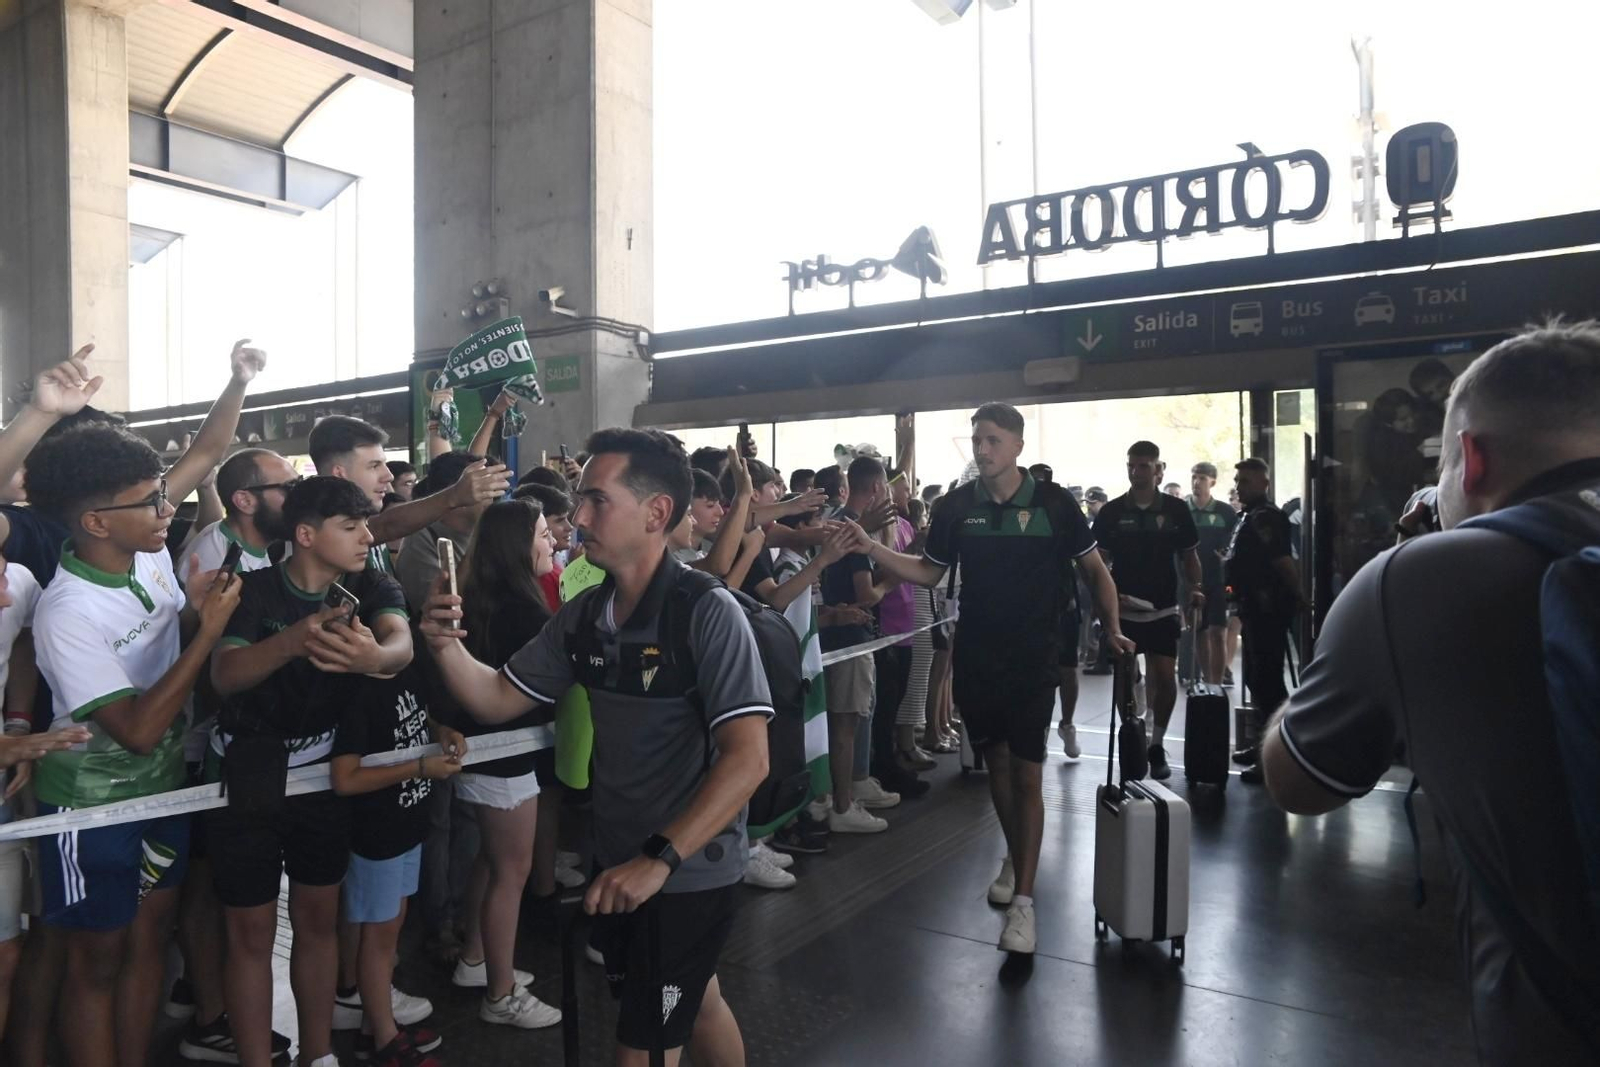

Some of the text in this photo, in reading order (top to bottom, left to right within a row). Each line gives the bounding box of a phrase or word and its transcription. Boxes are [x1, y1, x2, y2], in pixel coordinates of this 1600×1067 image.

[1412, 280, 1468, 306] Taxi
[1282, 299, 1323, 319] Bus
[1133, 310, 1198, 333] Salida
[464, 342, 479, 356] NO
[1133, 338, 1158, 349] EXIT
[453, 339, 532, 380] DOBA
[547, 365, 578, 382] SALIDA
